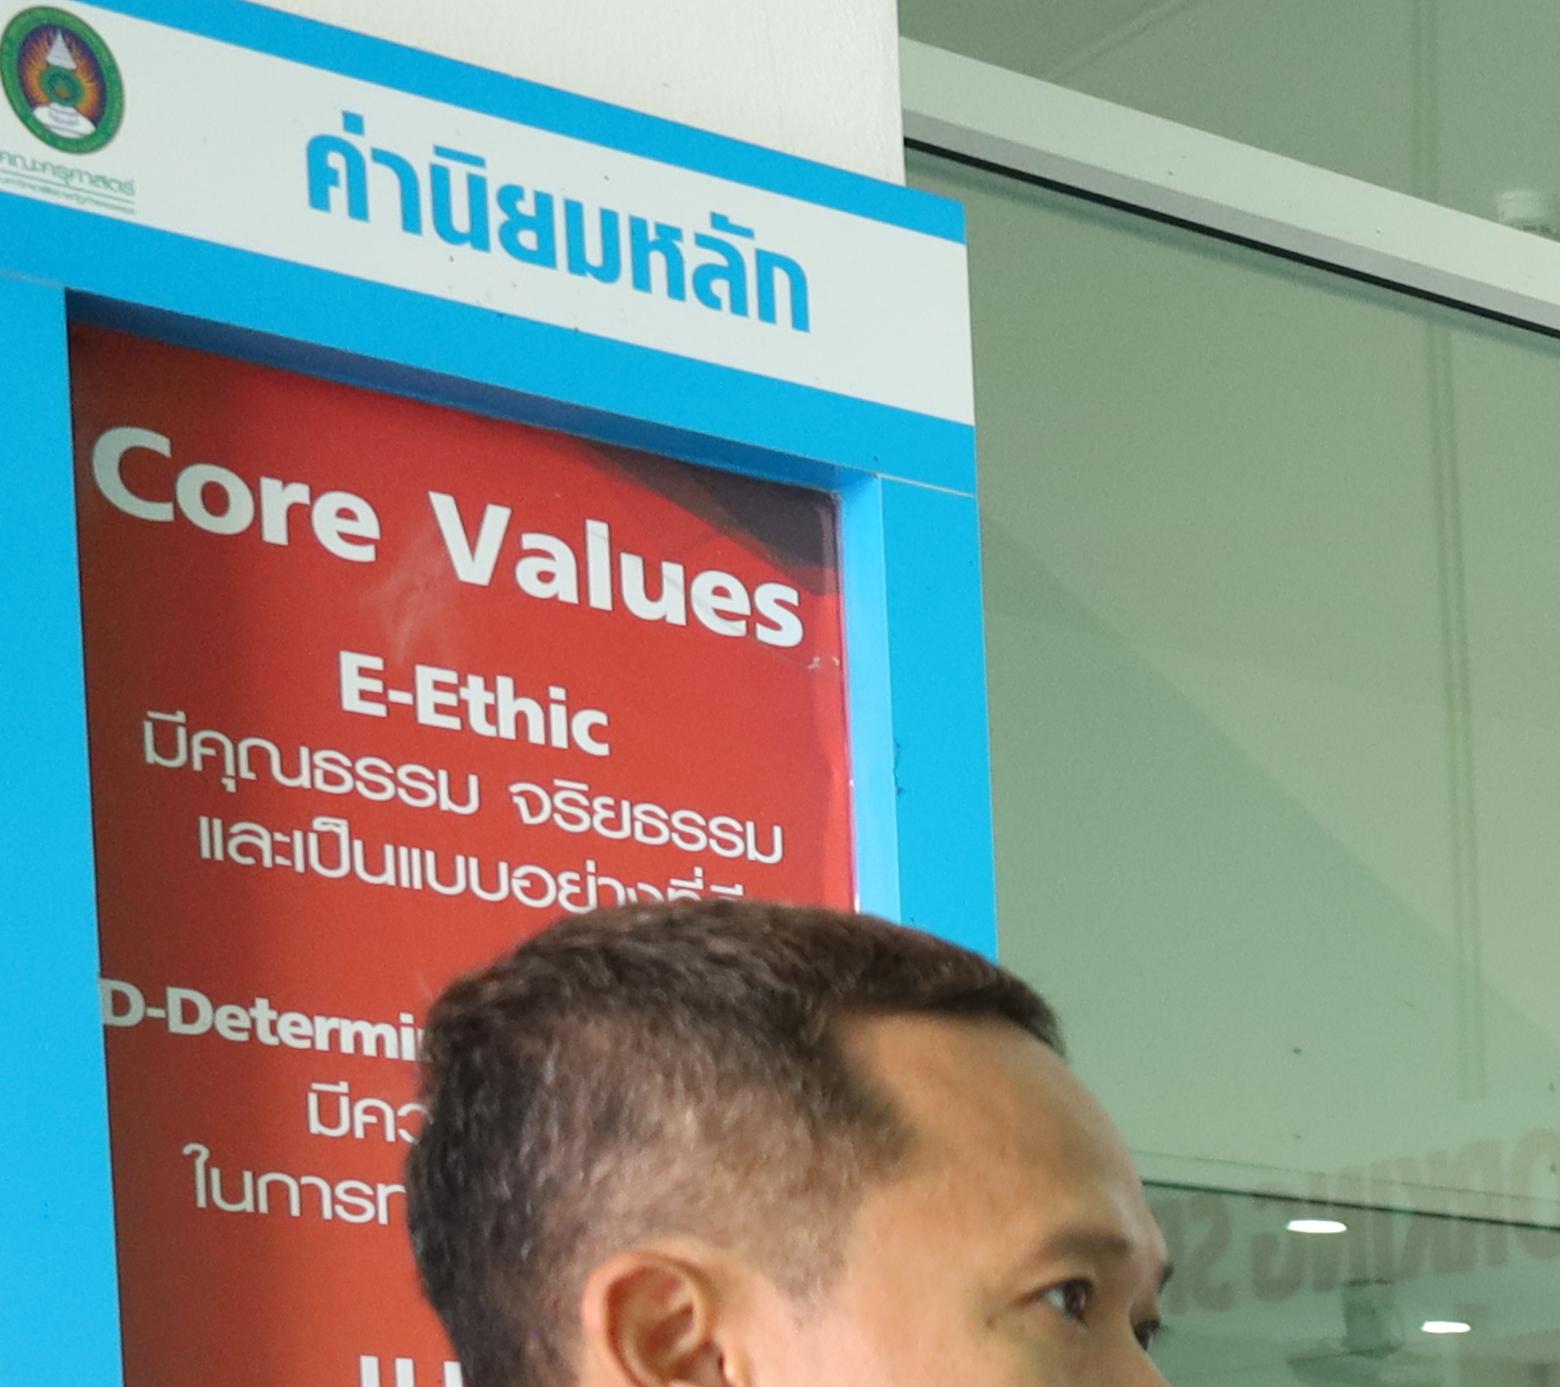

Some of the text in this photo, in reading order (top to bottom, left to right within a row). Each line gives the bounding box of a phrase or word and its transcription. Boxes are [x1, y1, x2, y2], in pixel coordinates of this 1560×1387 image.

[304, 111, 810, 333] ค่านิยมหลัก
[91, 426, 804, 649] Core Values
[142, 710, 783, 864] มีคุณธรรม จริยธรรม
[339, 650, 610, 757] E-Ethic
